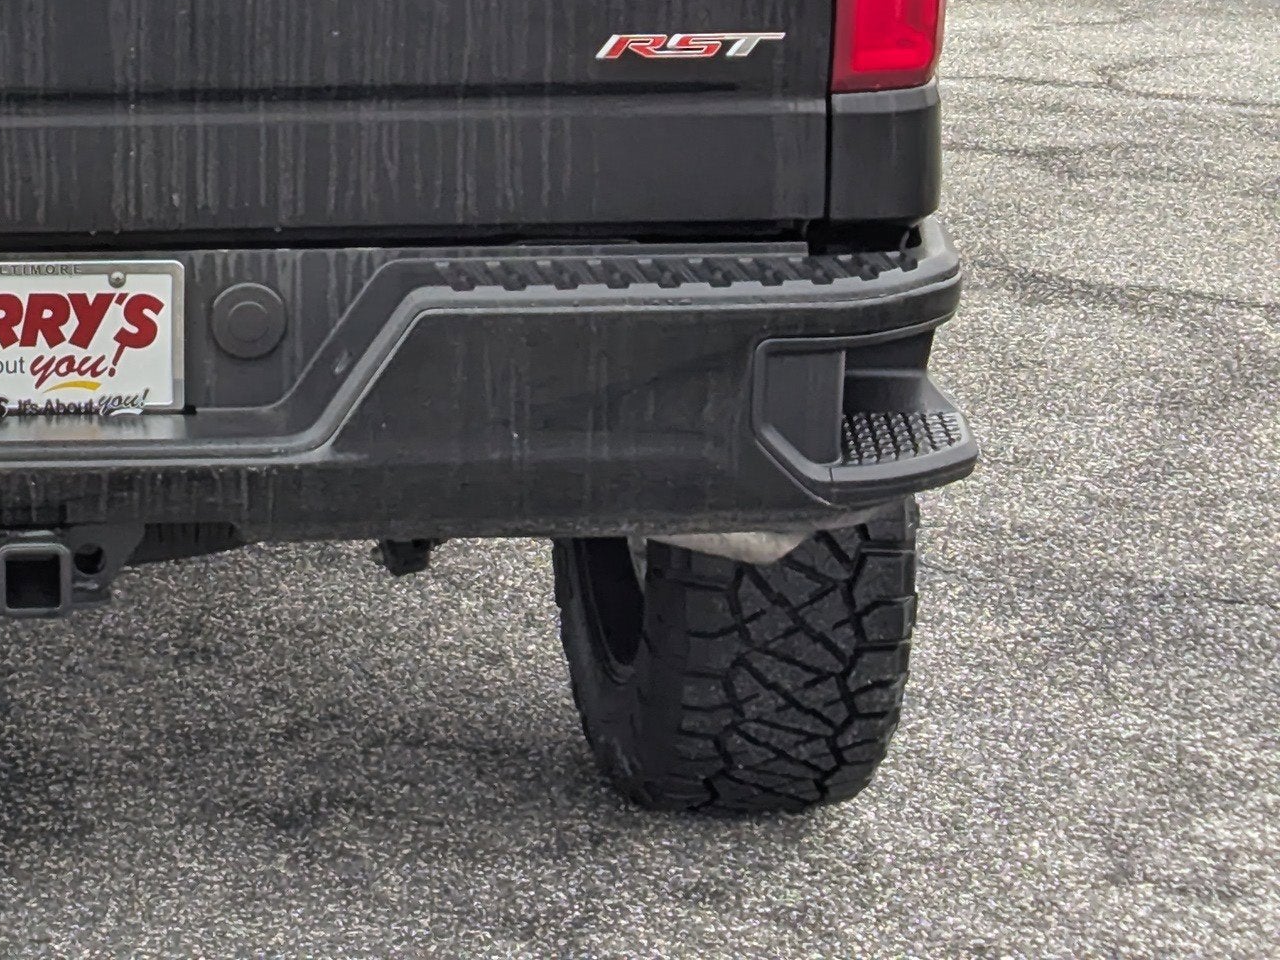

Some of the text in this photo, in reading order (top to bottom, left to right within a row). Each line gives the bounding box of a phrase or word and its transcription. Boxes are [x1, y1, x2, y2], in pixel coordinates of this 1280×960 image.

[596, 32, 786, 59] RST
[29, 344, 126, 390] you!
[42, 398, 93, 416] About
[96, 387, 150, 418] you!
